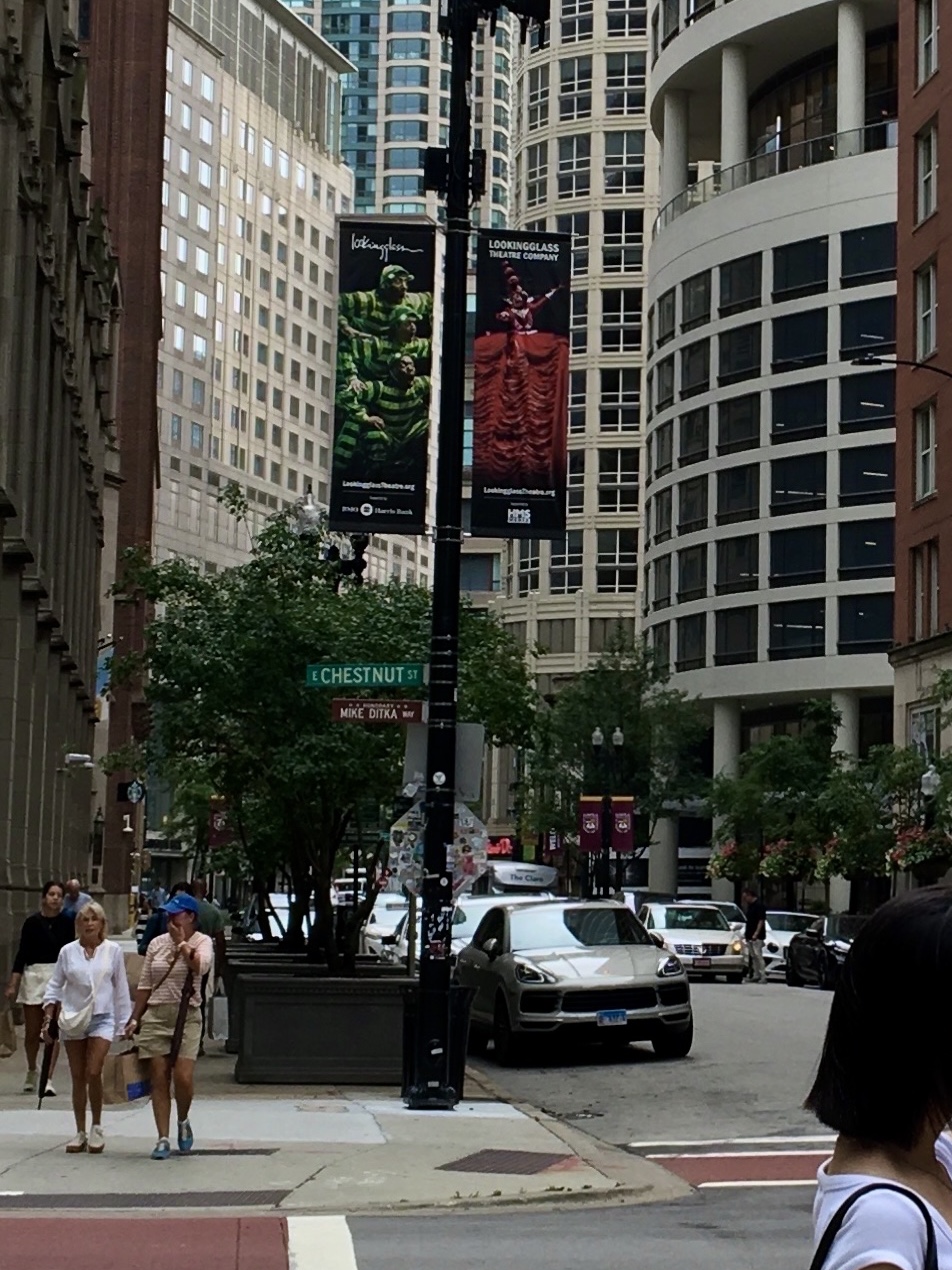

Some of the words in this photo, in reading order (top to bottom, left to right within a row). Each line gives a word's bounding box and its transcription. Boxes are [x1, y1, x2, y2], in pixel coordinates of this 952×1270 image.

[488, 240, 560, 253] LOOKINGGLASS
[489, 250, 522, 259] THEATRE
[522, 252, 560, 262] COMPANY
[312, 671, 318, 681] E
[320, 667, 405, 684] CHESTNUT
[407, 670, 418, 680] ST
[340, 708, 365, 719] MIKE
[368, 708, 398, 720] DITKA
[402, 710, 415, 719] WAY
